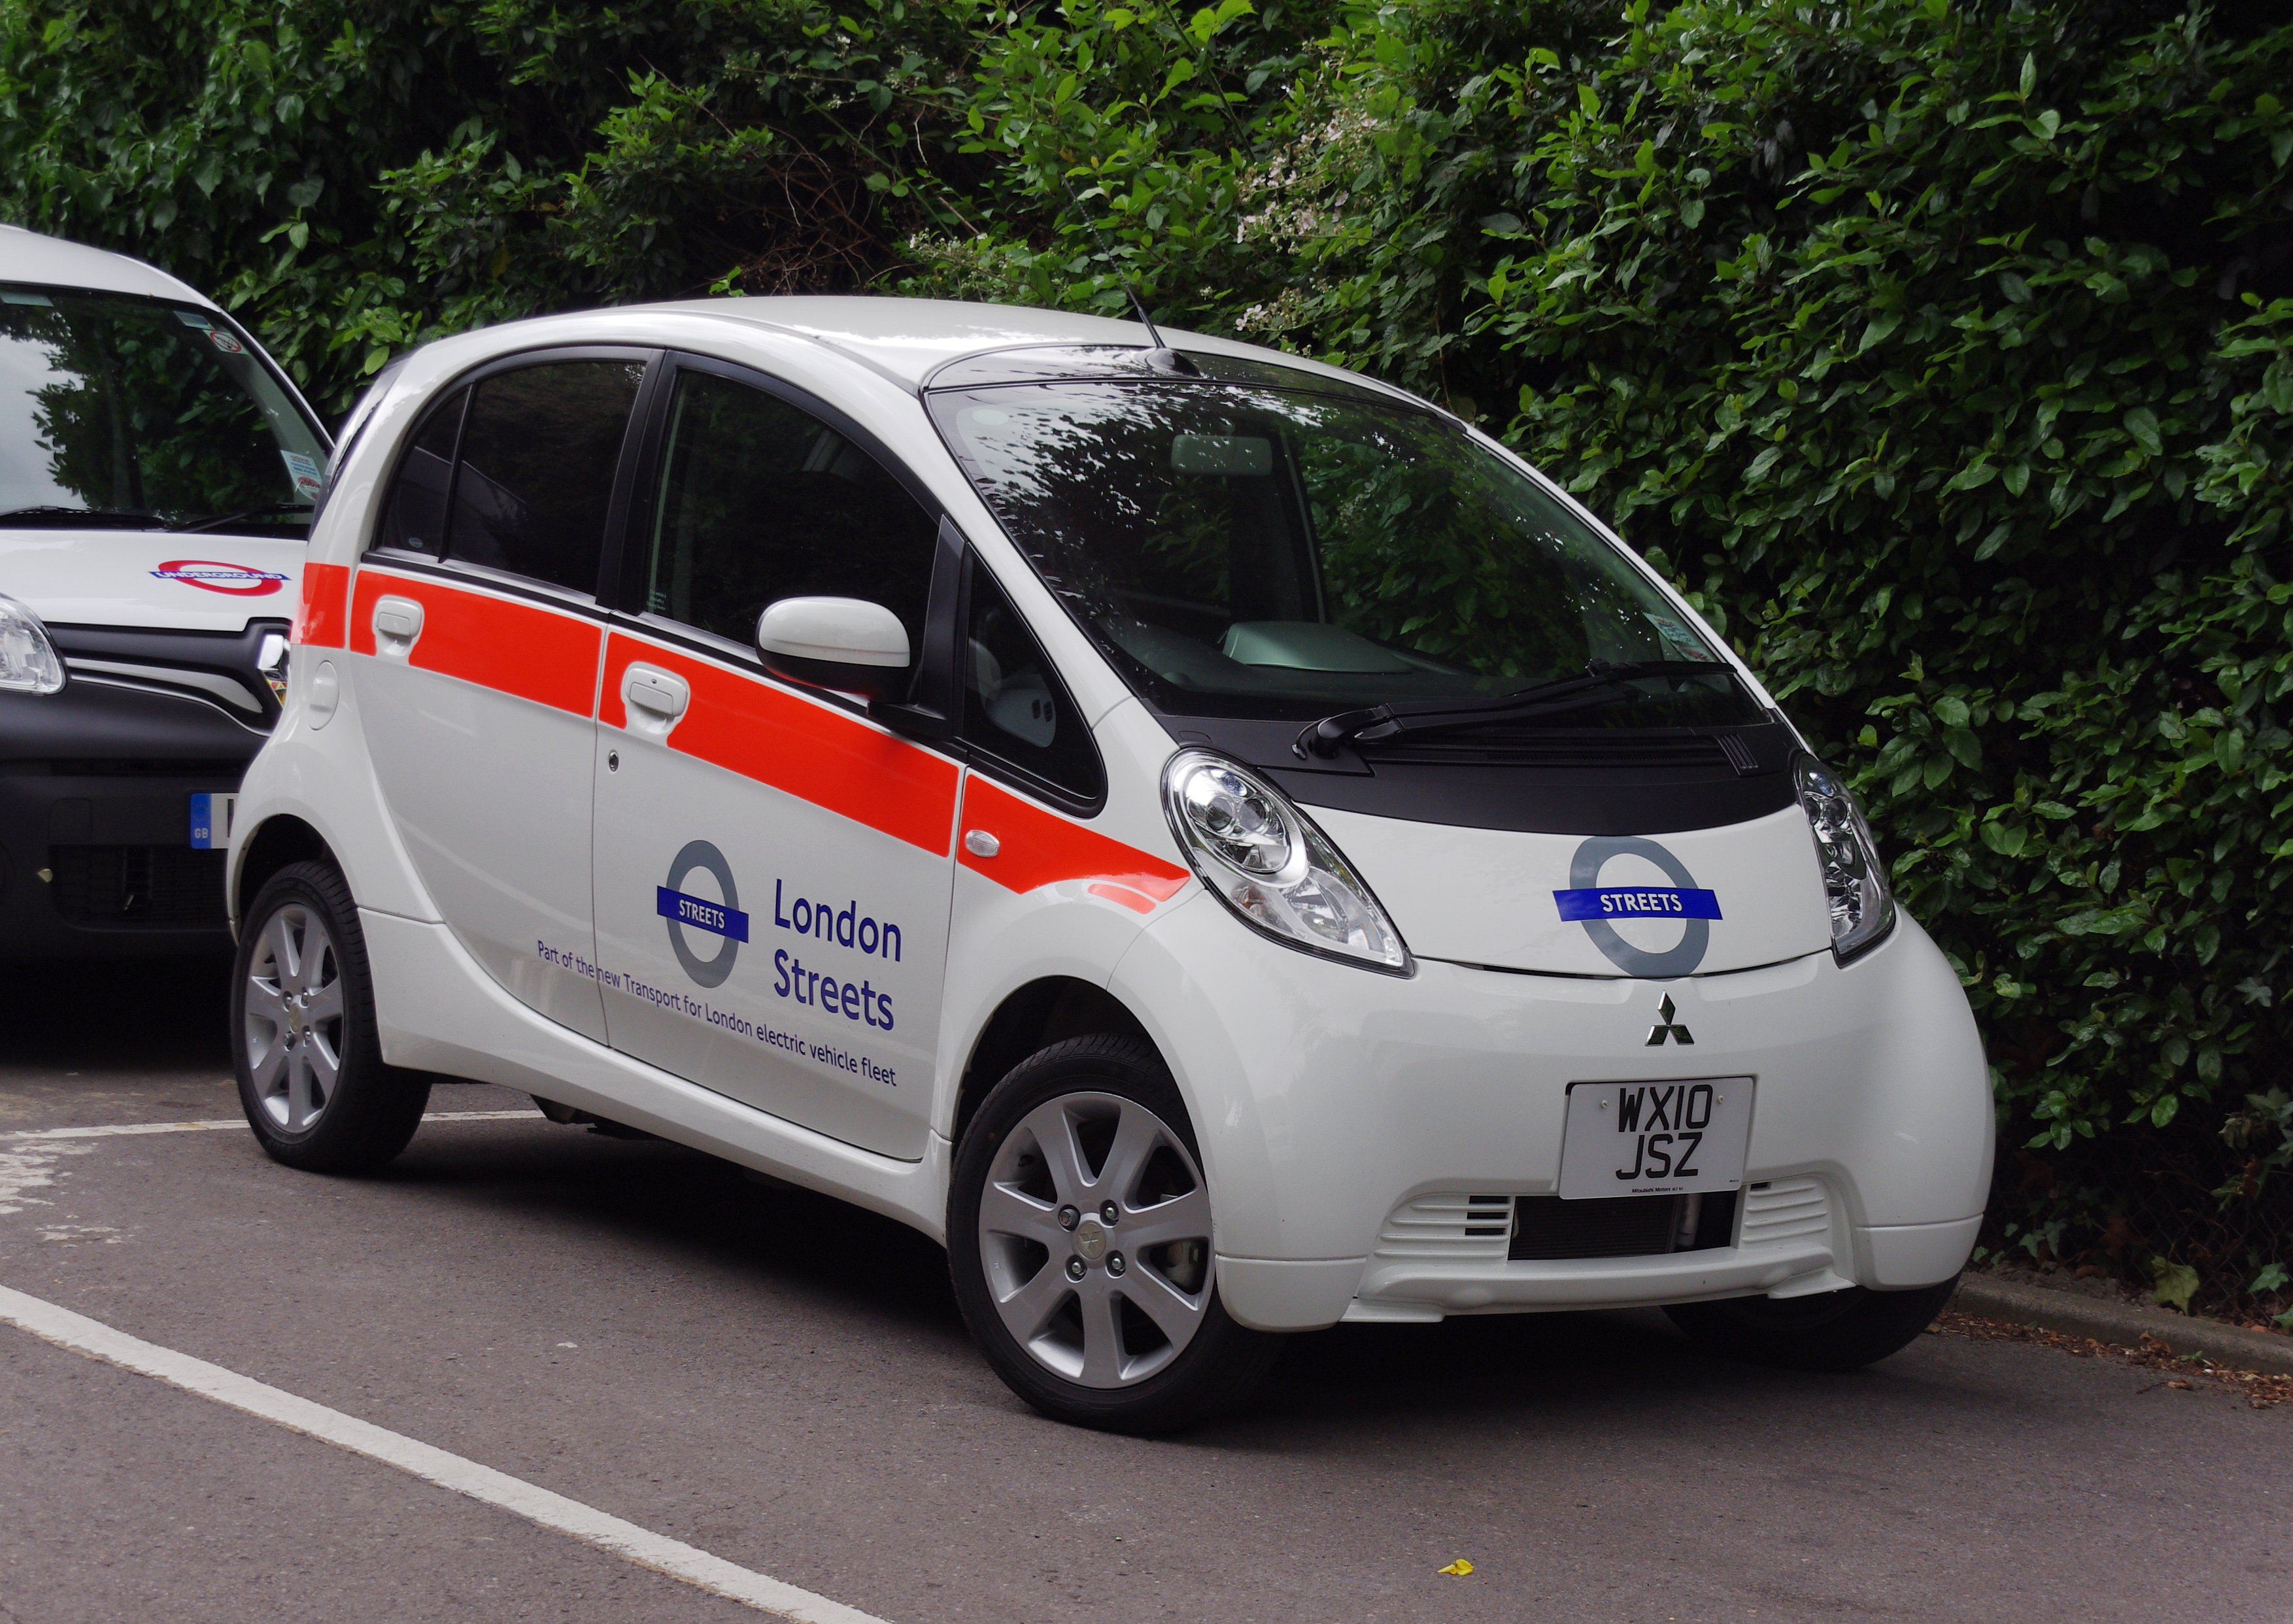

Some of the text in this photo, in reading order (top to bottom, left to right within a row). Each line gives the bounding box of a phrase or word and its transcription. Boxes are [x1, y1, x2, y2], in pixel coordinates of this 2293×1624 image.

[195, 828, 209, 839] GB
[679, 899, 725, 929] STREETS
[774, 879, 901, 962] London
[1599, 893, 1683, 913] STREETS
[774, 949, 894, 1030] Streets
[537, 940, 896, 1087] Part of the new Transport for London electric vehicle fleet
[1618, 1084, 1713, 1132] WX10
[1616, 1132, 1703, 1179] JSZ
